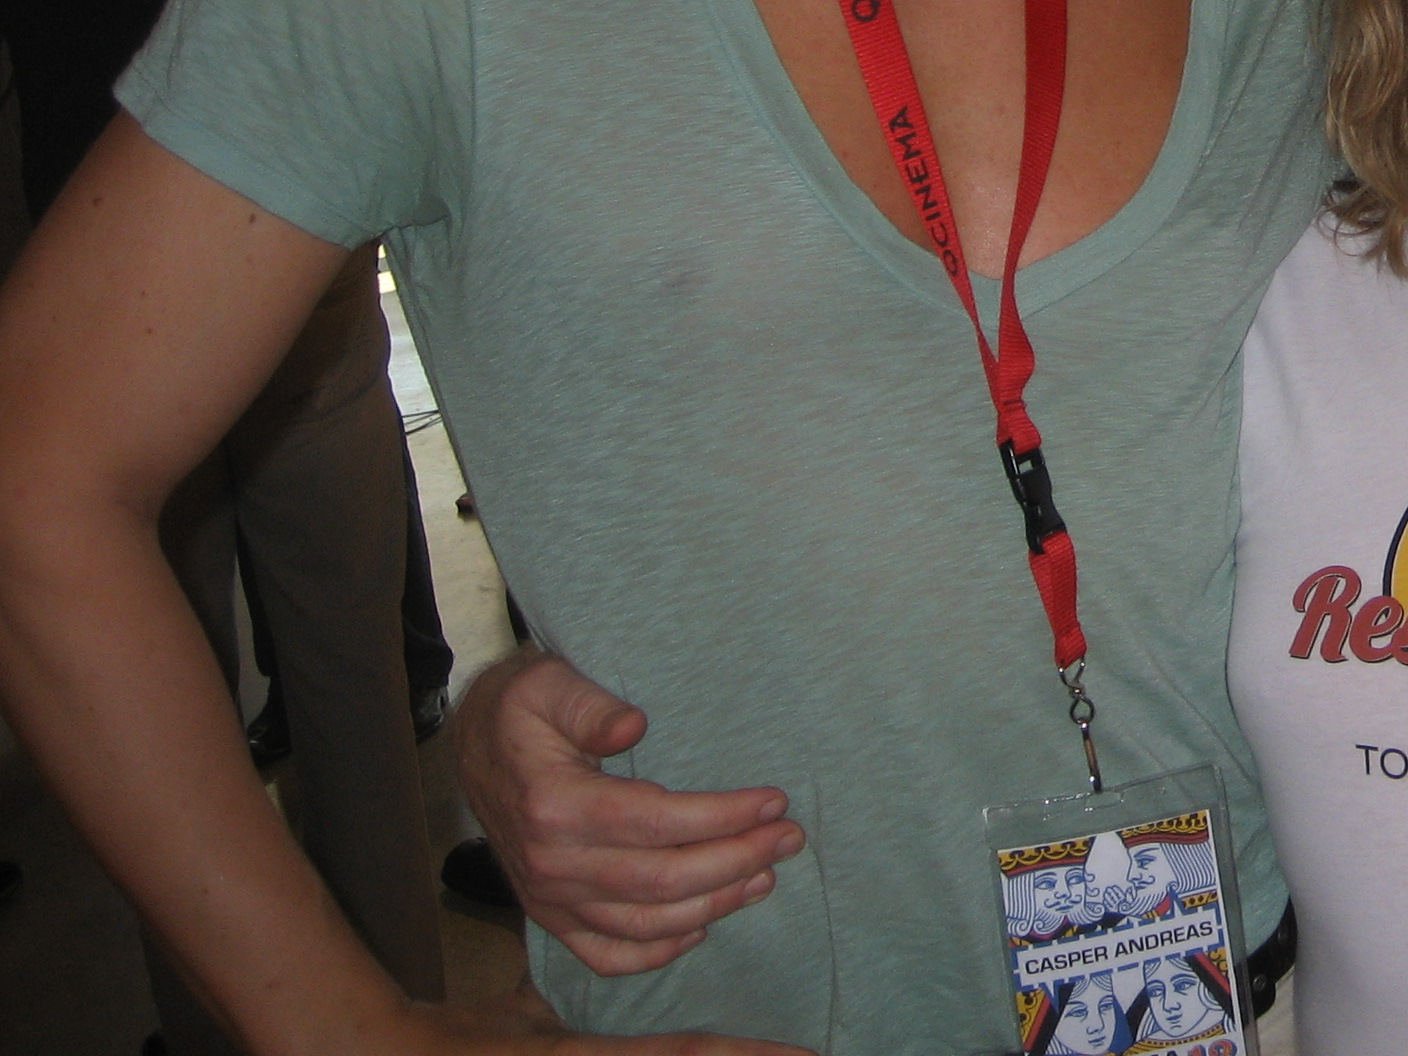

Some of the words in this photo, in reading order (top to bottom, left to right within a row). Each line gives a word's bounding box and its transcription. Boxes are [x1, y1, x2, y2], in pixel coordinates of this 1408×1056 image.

[889, 106, 958, 276] QCINEMA
[1024, 944, 1109, 976] CASPER
[1114, 920, 1214, 958] ANDREAS
